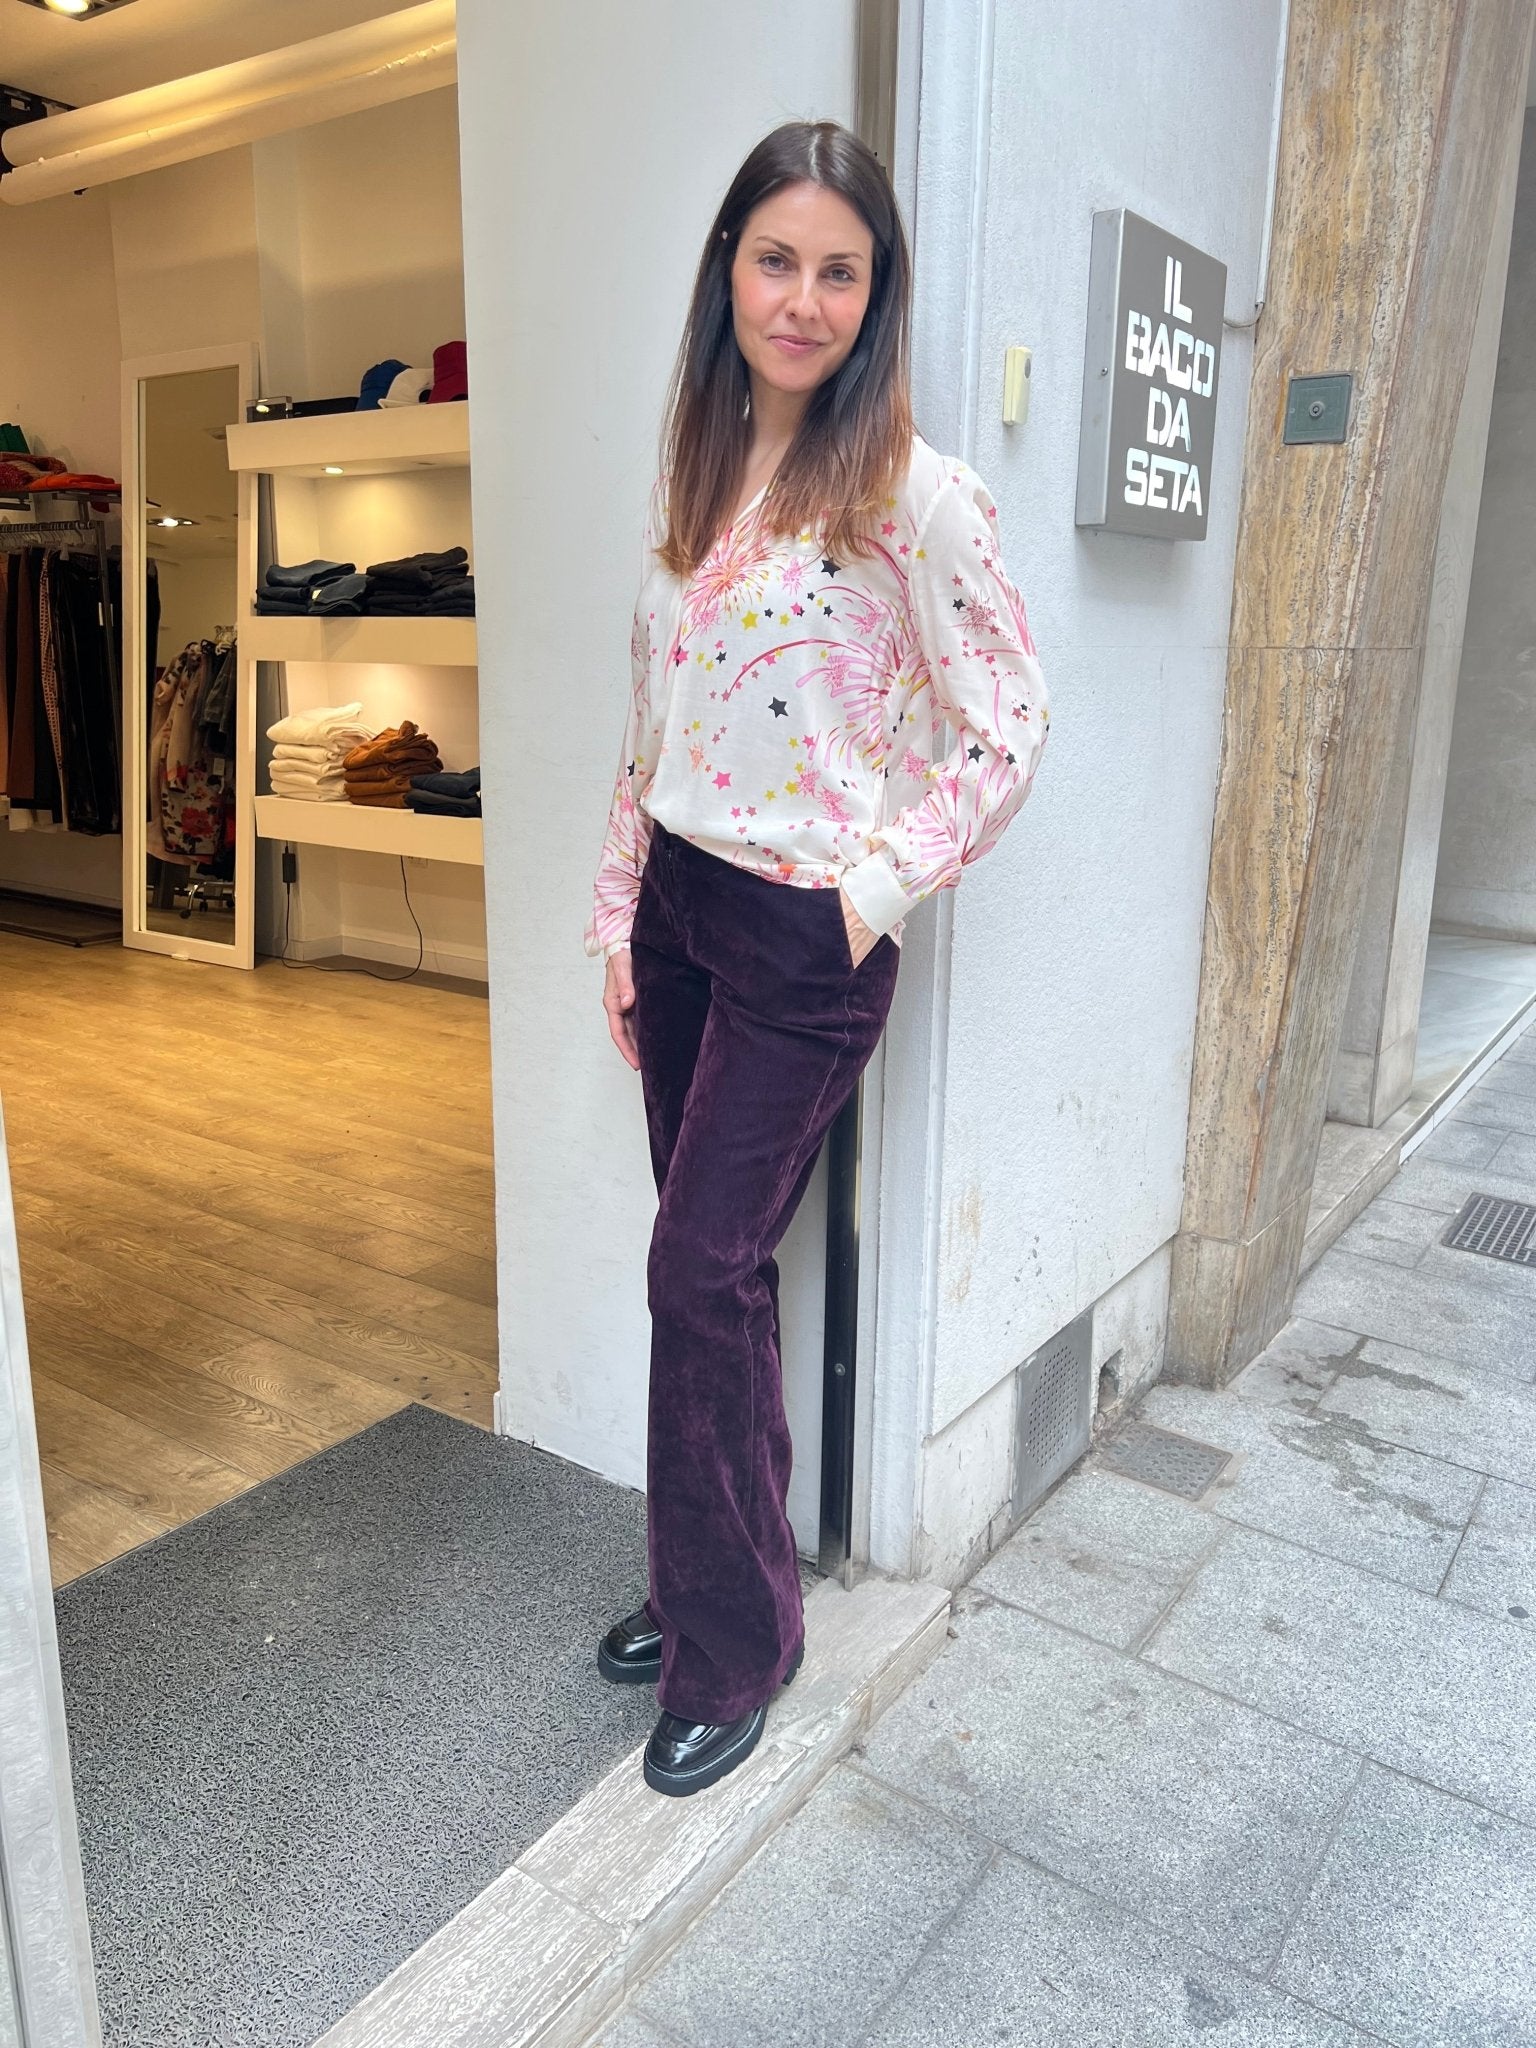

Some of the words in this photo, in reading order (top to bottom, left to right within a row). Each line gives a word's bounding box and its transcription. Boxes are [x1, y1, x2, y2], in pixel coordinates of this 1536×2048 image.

[1164, 255, 1193, 324] IL
[1125, 309, 1215, 398] BACO
[1146, 386, 1192, 453] DA
[1124, 447, 1203, 517] SETA
